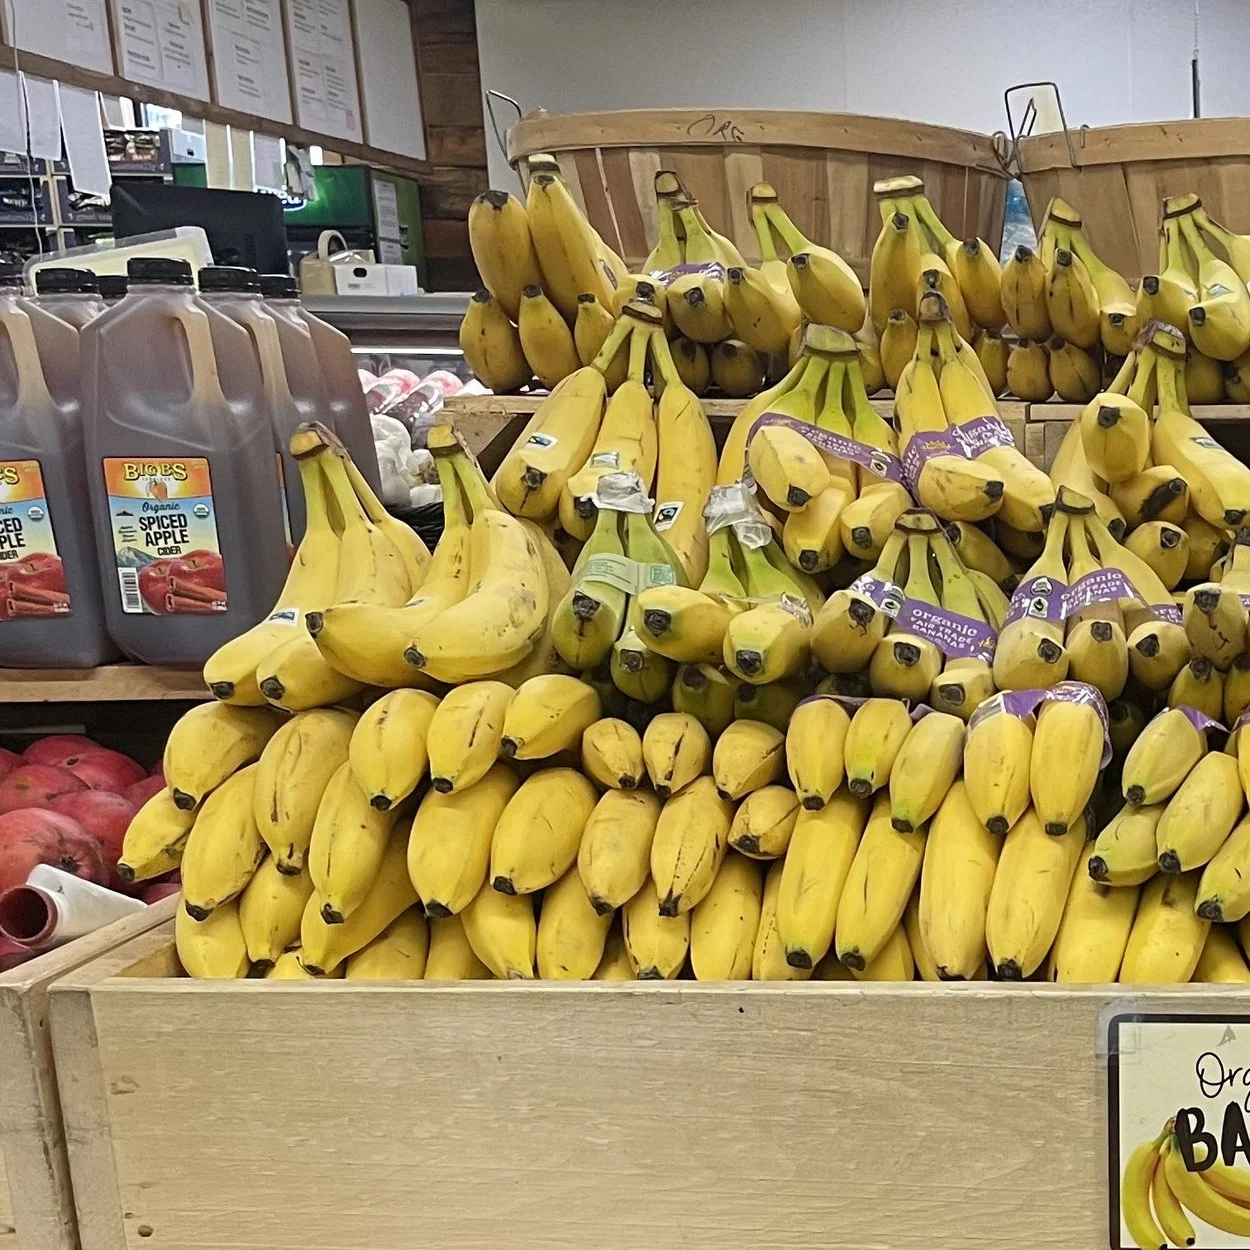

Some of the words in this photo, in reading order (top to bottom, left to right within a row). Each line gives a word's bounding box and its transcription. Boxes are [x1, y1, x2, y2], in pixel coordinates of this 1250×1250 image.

[124, 463, 158, 481] BIG
[142, 502, 181, 514] Organic
[139, 513, 188, 532] SPICED
[145, 529, 189, 547] APPLE
[158, 547, 182, 556] CIDER
[1060, 572, 1123, 599] organic
[910, 616, 936, 632] FAIR
[939, 626, 973, 645] TRADE
[912, 608, 978, 636] organic
[912, 624, 965, 649] BANANAS
